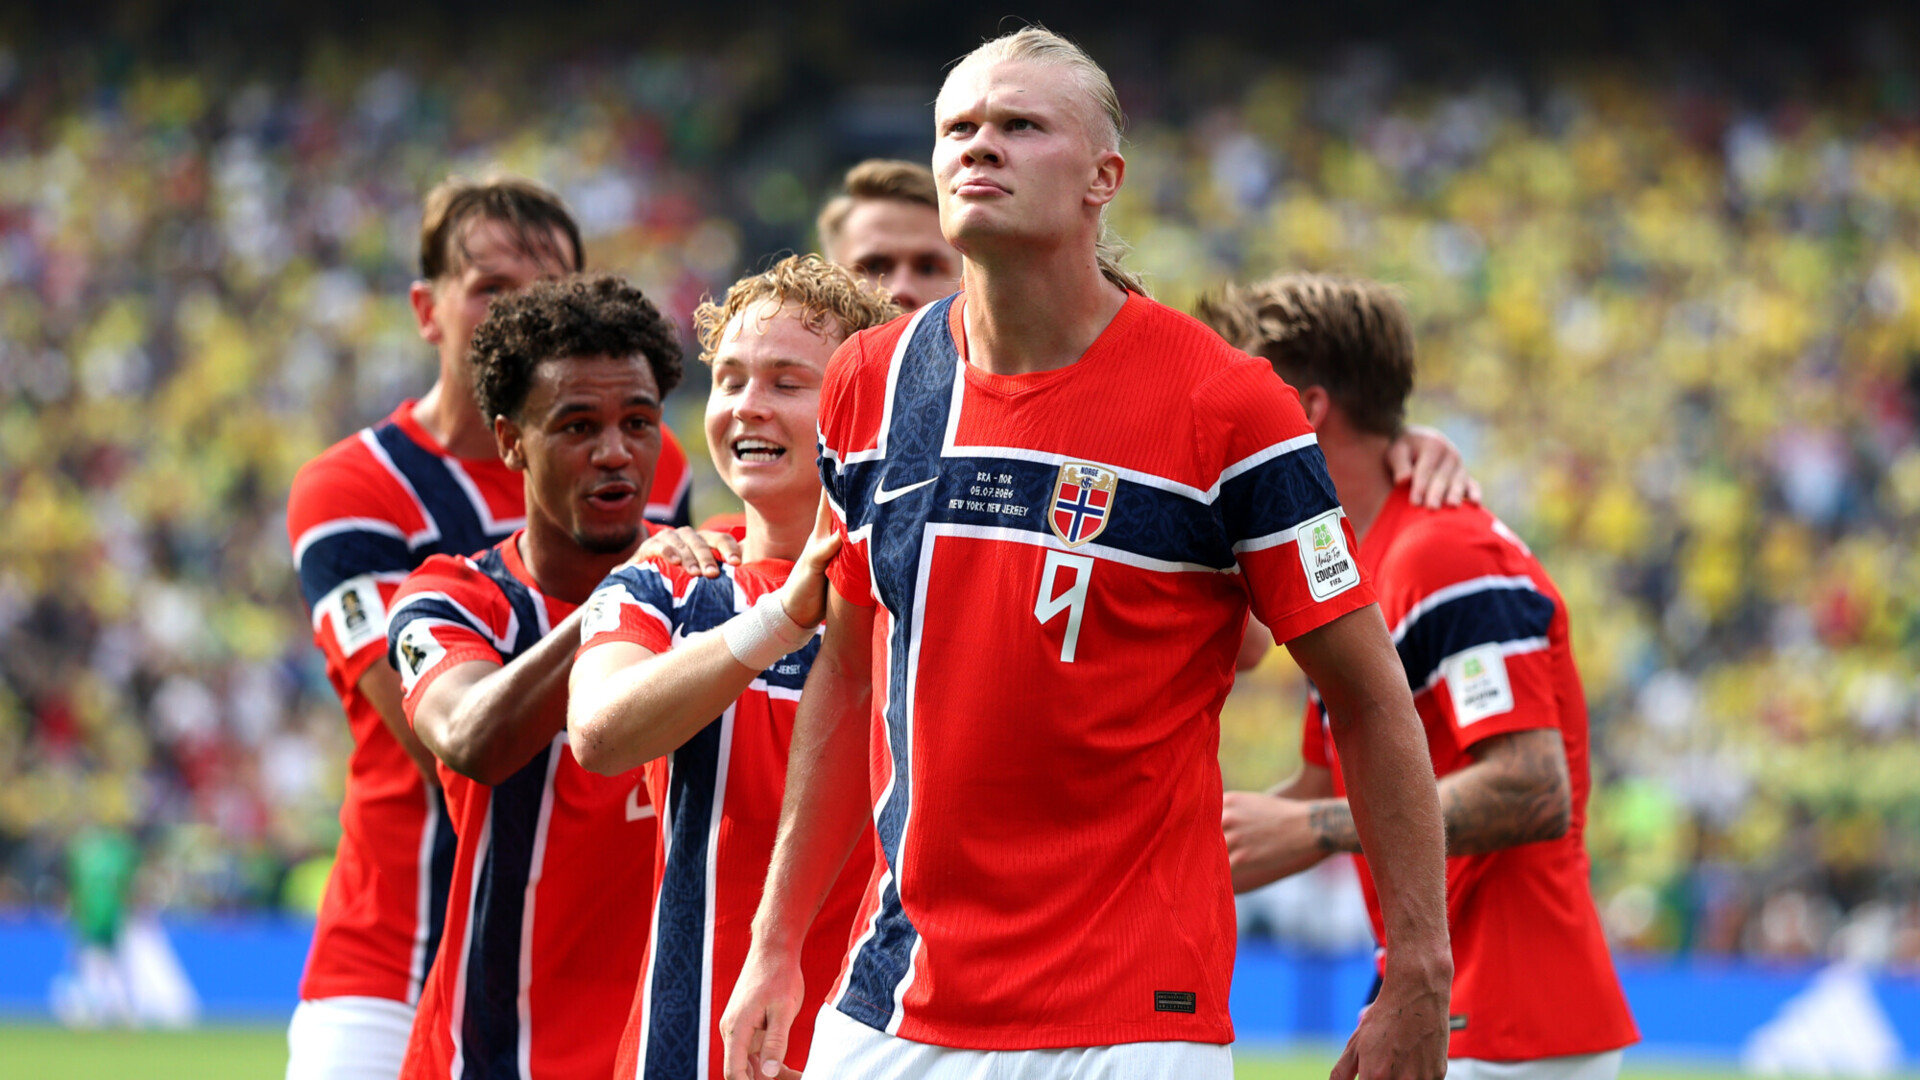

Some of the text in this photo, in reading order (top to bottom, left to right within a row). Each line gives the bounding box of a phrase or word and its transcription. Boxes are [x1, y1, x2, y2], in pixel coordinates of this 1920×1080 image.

[976, 471, 991, 482] BRA
[998, 473, 1013, 485] NOR
[1080, 466, 1098, 478] NORGE
[970, 485, 1014, 499] 05.07.2026
[948, 498, 1029, 517] NEW YORK NEW JERSEY
[1314, 559, 1349, 583] EDUCATION
[1329, 577, 1342, 587] FIFA
[1034, 549, 1095, 663] 9
